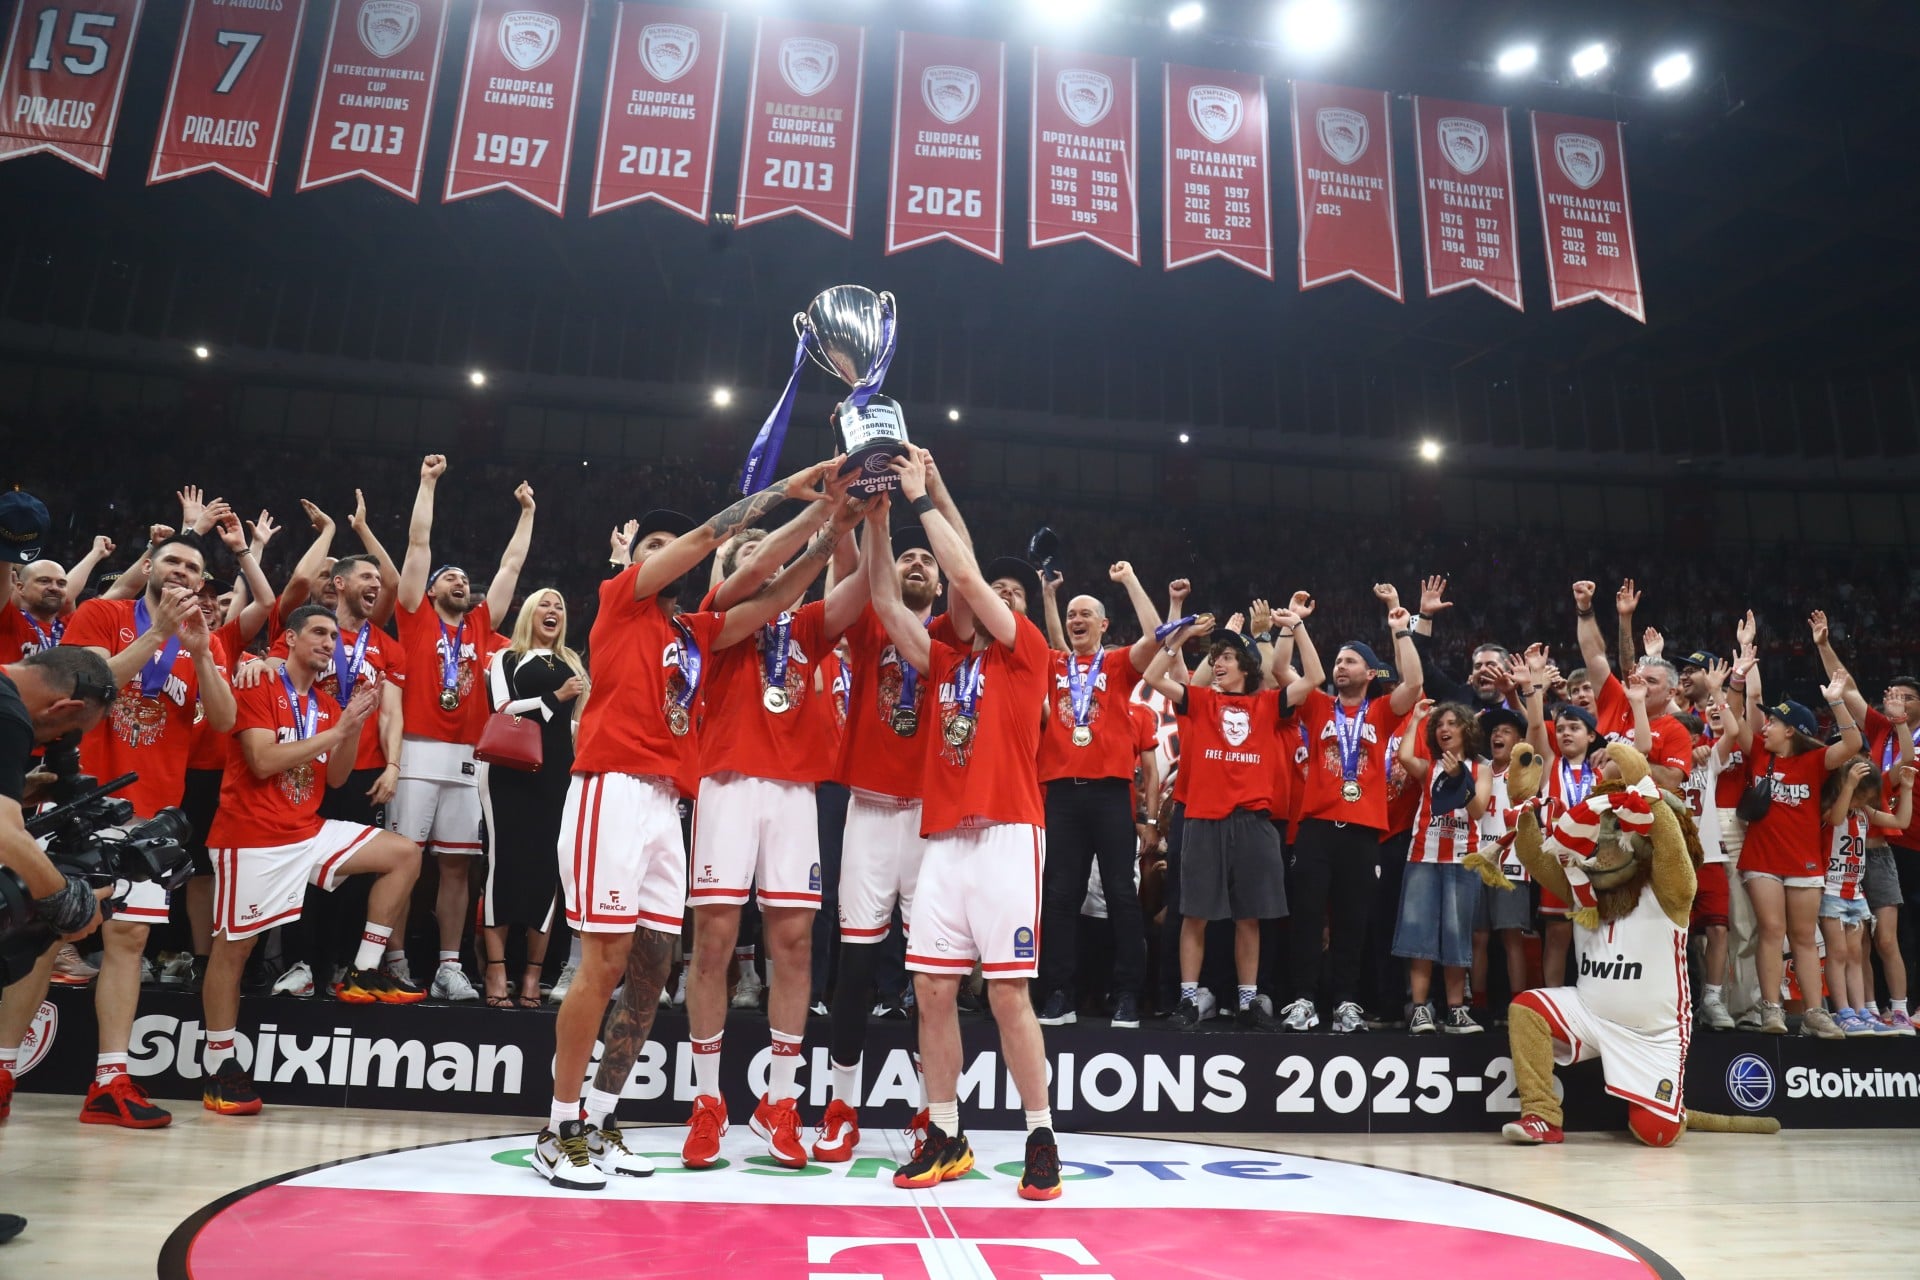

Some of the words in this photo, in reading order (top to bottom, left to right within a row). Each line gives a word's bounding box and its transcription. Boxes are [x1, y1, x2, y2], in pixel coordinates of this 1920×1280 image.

[28, 8, 116, 76] 15
[215, 30, 263, 94] 7
[333, 63, 425, 81] INTERCONTINENTAL
[367, 81, 387, 92] CUP
[489, 77, 554, 95] EUROPEAN
[339, 93, 410, 111] CHAMPIONS
[484, 90, 555, 109] CHAMPIONS
[631, 89, 695, 106] EUROPEAN
[14, 94, 96, 129] PIRAEUS
[627, 103, 696, 120] CHAMPIONS
[181, 115, 260, 148] PIRAEUS
[772, 117, 834, 134] EUROPEAN
[330, 121, 404, 155] 2013
[768, 131, 836, 148] CHAMPIONS
[918, 131, 980, 147] EUROPEAN
[473, 132, 549, 168] 1997
[915, 144, 982, 160] CHAMPIONS
[1057, 146, 1112, 163] ΕΛΛΑΔΑΣ
[619, 144, 692, 178] 2012
[763, 157, 834, 192] 2013
[1050, 164, 1078, 179] 1949
[1091, 170, 1118, 184] 1960
[1190, 163, 1244, 180] ΕΛΛΑΔΑΣ
[1050, 178, 1078, 193] 1976
[1091, 184, 1118, 198] 1978
[1184, 182, 1211, 196] 1996
[1224, 186, 1250, 199] 1997
[1320, 184, 1372, 202] ΕΛΛΑΔΑΣ
[907, 185, 982, 218] 2026
[1051, 193, 1077, 207] 1993
[1091, 198, 1118, 212] 1994
[1184, 197, 1211, 210] 2012
[1225, 201, 1251, 214] 2015
[1315, 203, 1342, 216] 2025
[1443, 193, 1492, 211] ΕΛΛΑΔΑΣ
[1071, 210, 1098, 224] 1995
[1184, 211, 1211, 225] 2016
[1225, 215, 1251, 228] 2022
[1439, 211, 1463, 226] 1976
[1475, 217, 1498, 231] 1977
[1563, 207, 1611, 225] ΕΛΛΑΔΑΣ
[1204, 228, 1232, 241] 2023
[1440, 226, 1464, 240] 1978
[1560, 225, 1584, 239] 2010
[1595, 230, 1618, 244] 2011
[1441, 240, 1465, 254] 1994
[1477, 245, 1500, 259] 1997
[1562, 239, 1586, 253] 2022
[1597, 244, 1620, 258] 2023
[1460, 256, 1485, 271] 2002
[1563, 253, 1587, 267] 2024
[848, 474, 902, 487] toixima
[864, 482, 897, 494] GBL
[1205, 749, 1223, 760] FREE
[1839, 835, 1864, 858] 20
[599, 902, 628, 912] FlexCar
[366, 933, 387, 945] GSA
[1580, 952, 1643, 980] bwin
[772, 1043, 793, 1053] SA
[1275, 1054, 1565, 1114] 2025-2
